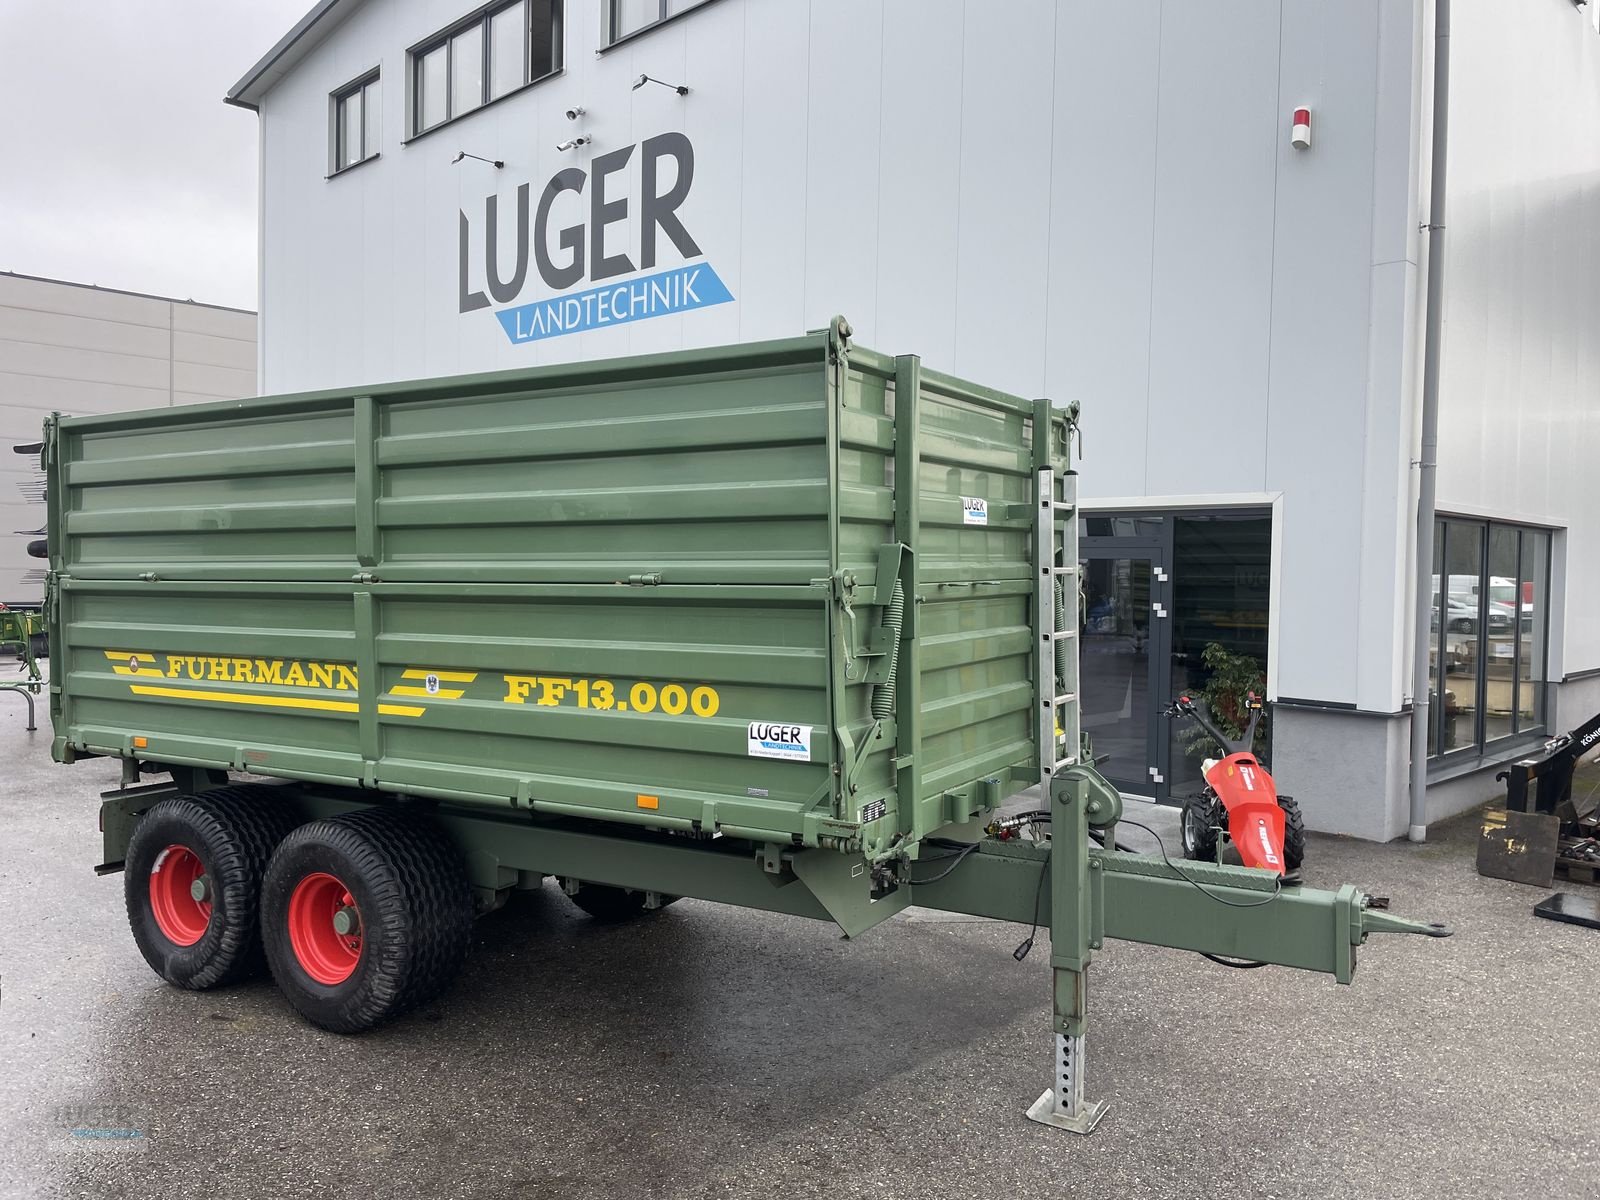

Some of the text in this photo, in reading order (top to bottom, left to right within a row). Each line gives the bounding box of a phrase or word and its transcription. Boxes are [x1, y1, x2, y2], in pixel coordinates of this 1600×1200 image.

[459, 132, 703, 313] LUGER
[516, 270, 701, 339] LANDTECHNIK
[166, 655, 359, 690] FUHRMANN
[503, 675, 720, 718] FF13.000
[750, 724, 802, 744] LUGER
